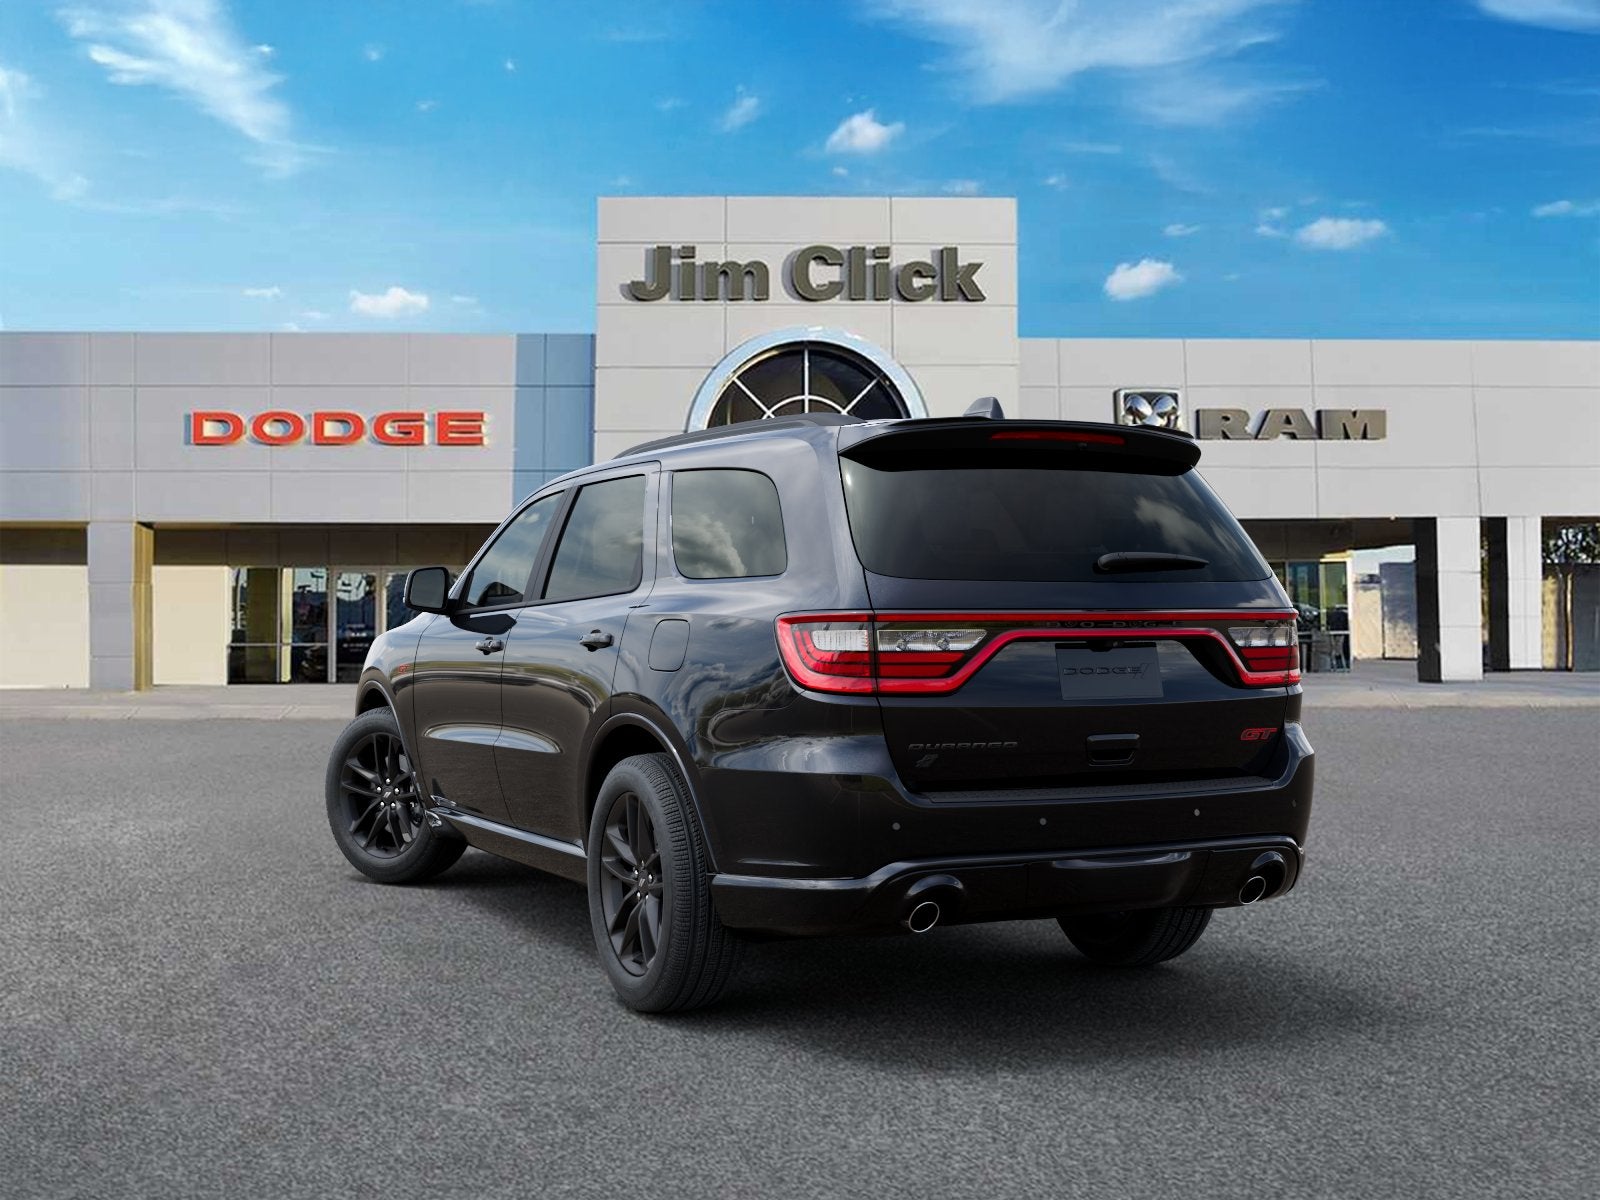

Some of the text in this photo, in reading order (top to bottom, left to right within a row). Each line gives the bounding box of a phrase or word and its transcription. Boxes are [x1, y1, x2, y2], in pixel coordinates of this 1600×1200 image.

[622, 245, 986, 301] Jim Click
[190, 411, 486, 446] DODGE
[1195, 408, 1387, 440] RAM
[1063, 666, 1143, 676] DODGE
[1240, 727, 1278, 741] GT
